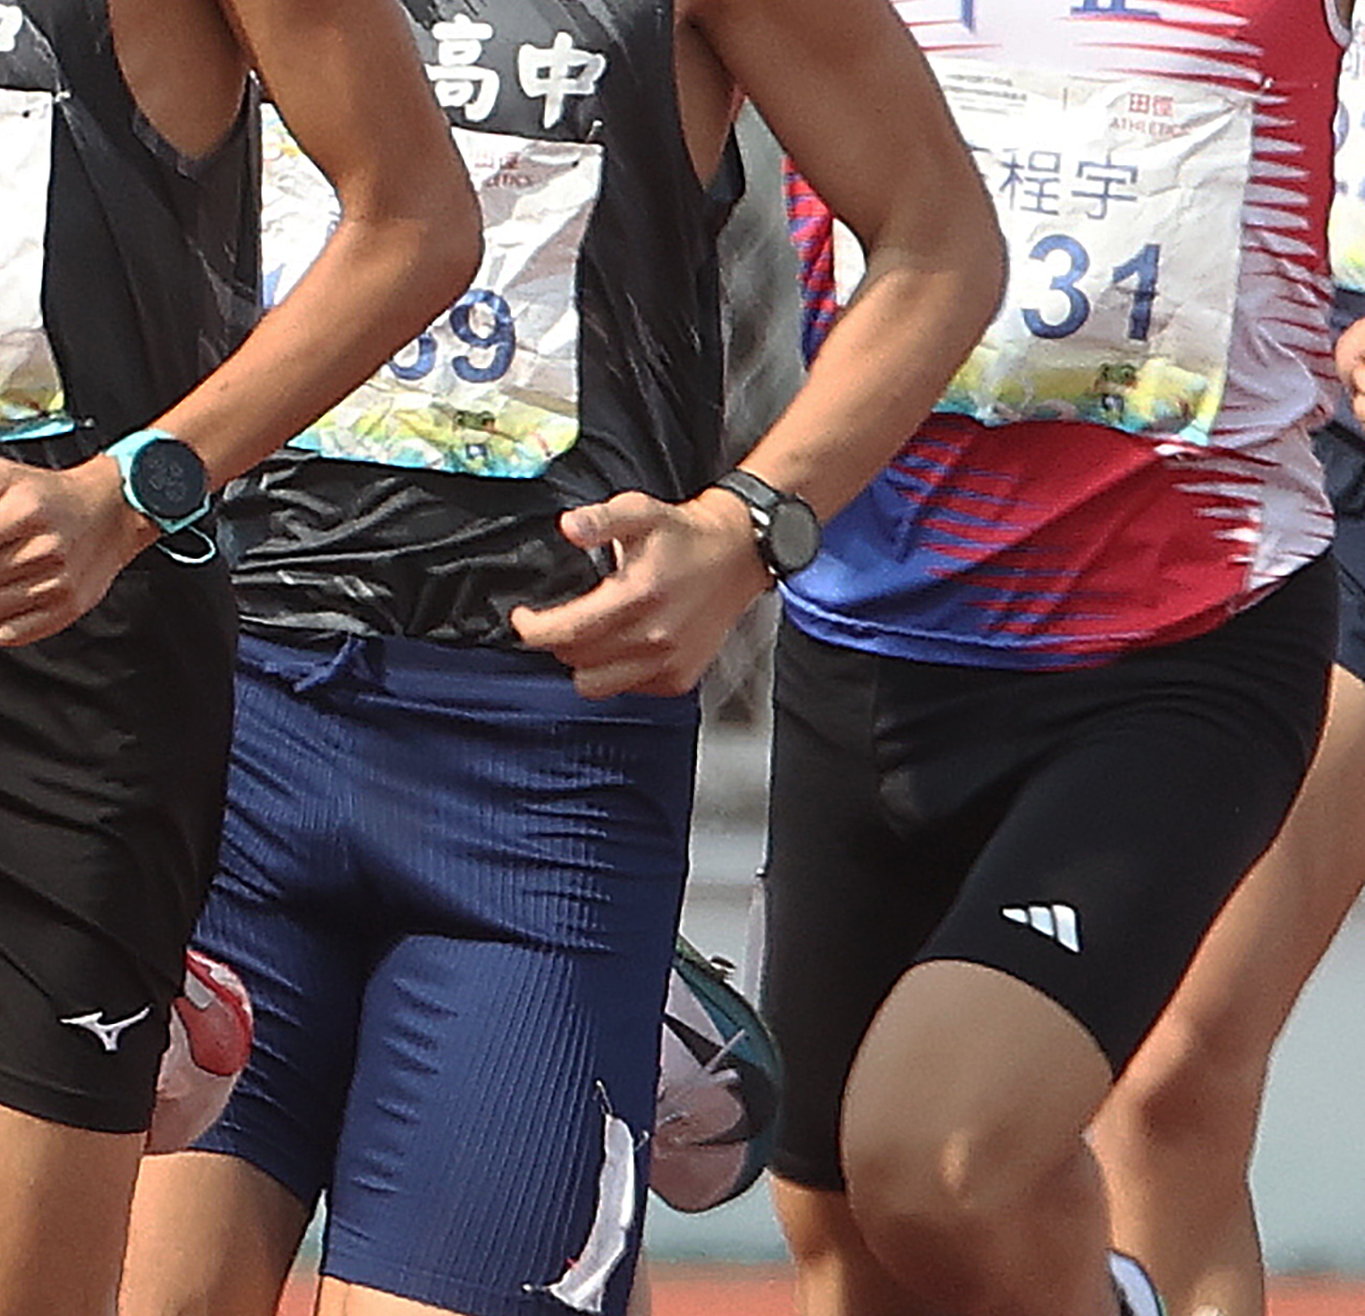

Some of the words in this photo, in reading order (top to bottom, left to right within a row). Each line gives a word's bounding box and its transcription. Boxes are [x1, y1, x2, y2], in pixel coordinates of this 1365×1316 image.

[424, 13, 608, 128] 高中
[969, 145, 1138, 220] 程宇
[1021, 234, 1163, 342] 31
